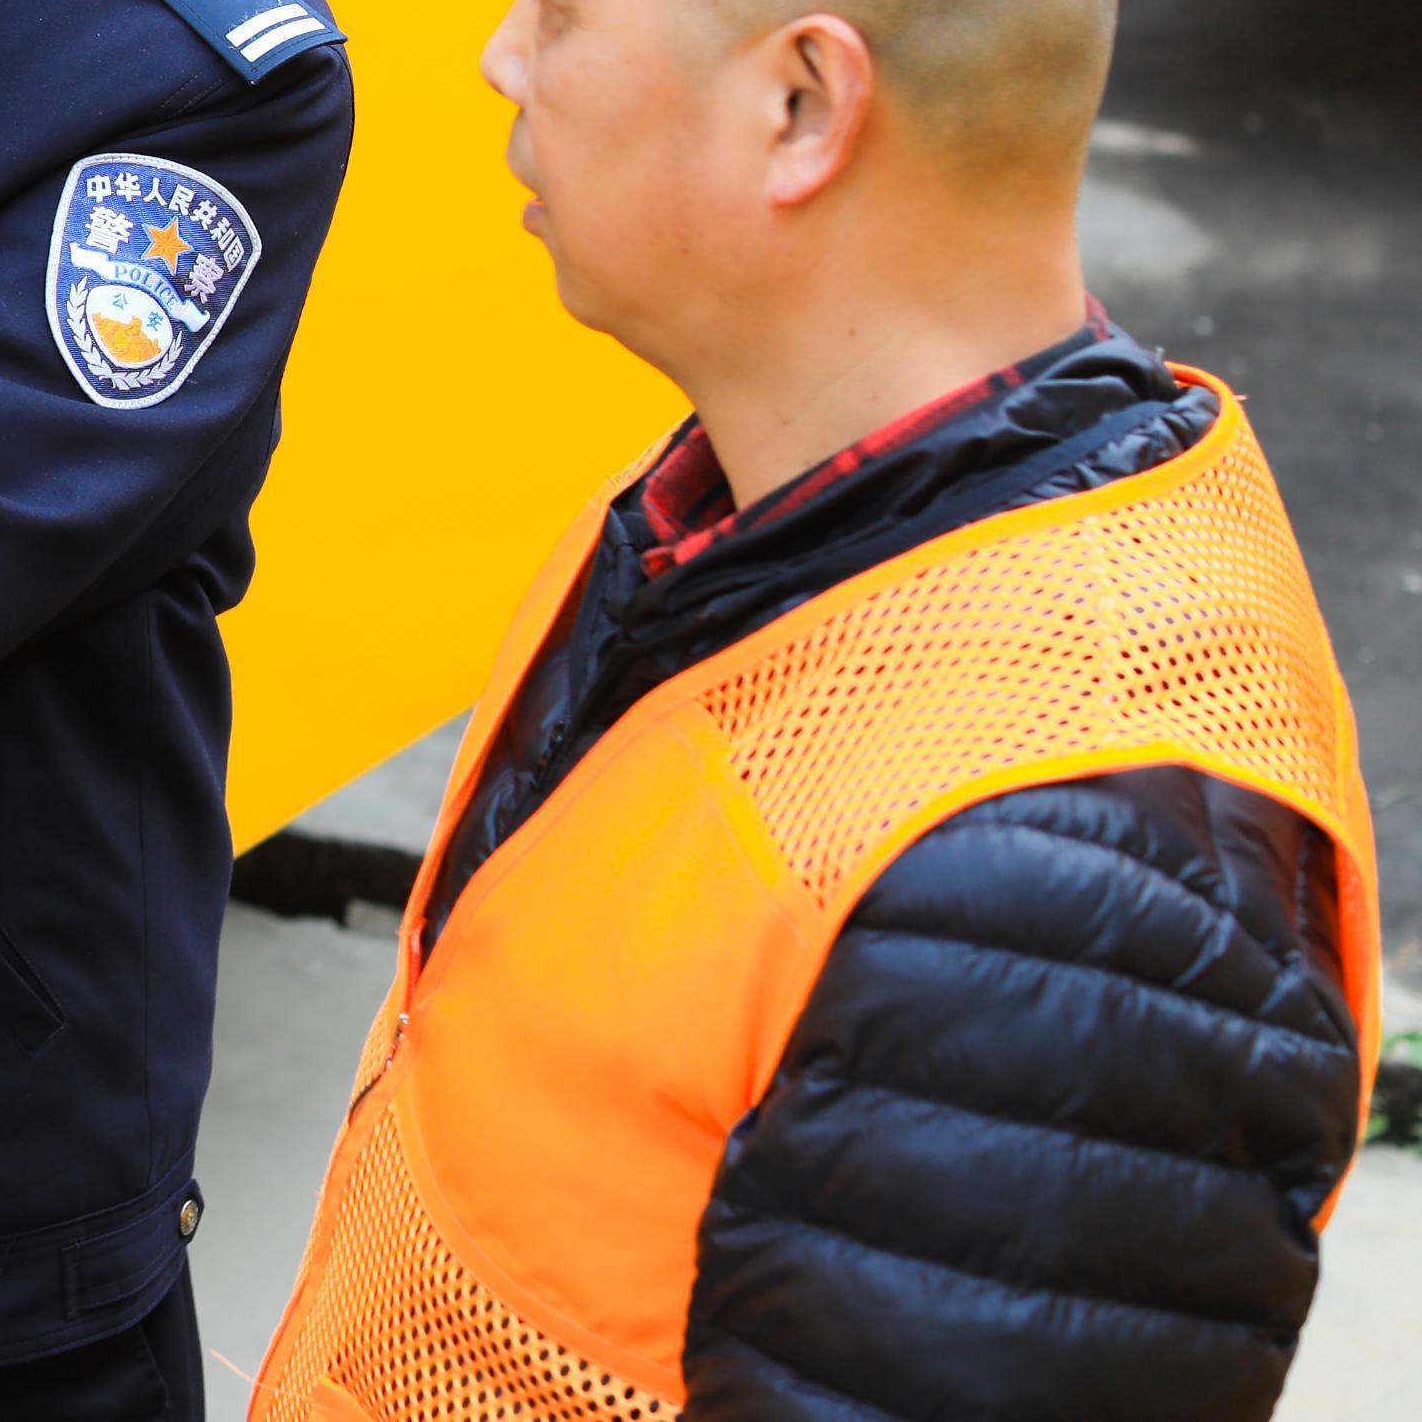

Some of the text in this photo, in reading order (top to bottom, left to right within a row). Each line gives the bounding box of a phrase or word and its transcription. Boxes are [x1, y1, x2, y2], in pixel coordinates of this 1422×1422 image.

[86, 172, 245, 273] 中华人民共和国
[113, 264, 178, 310] POLICE
